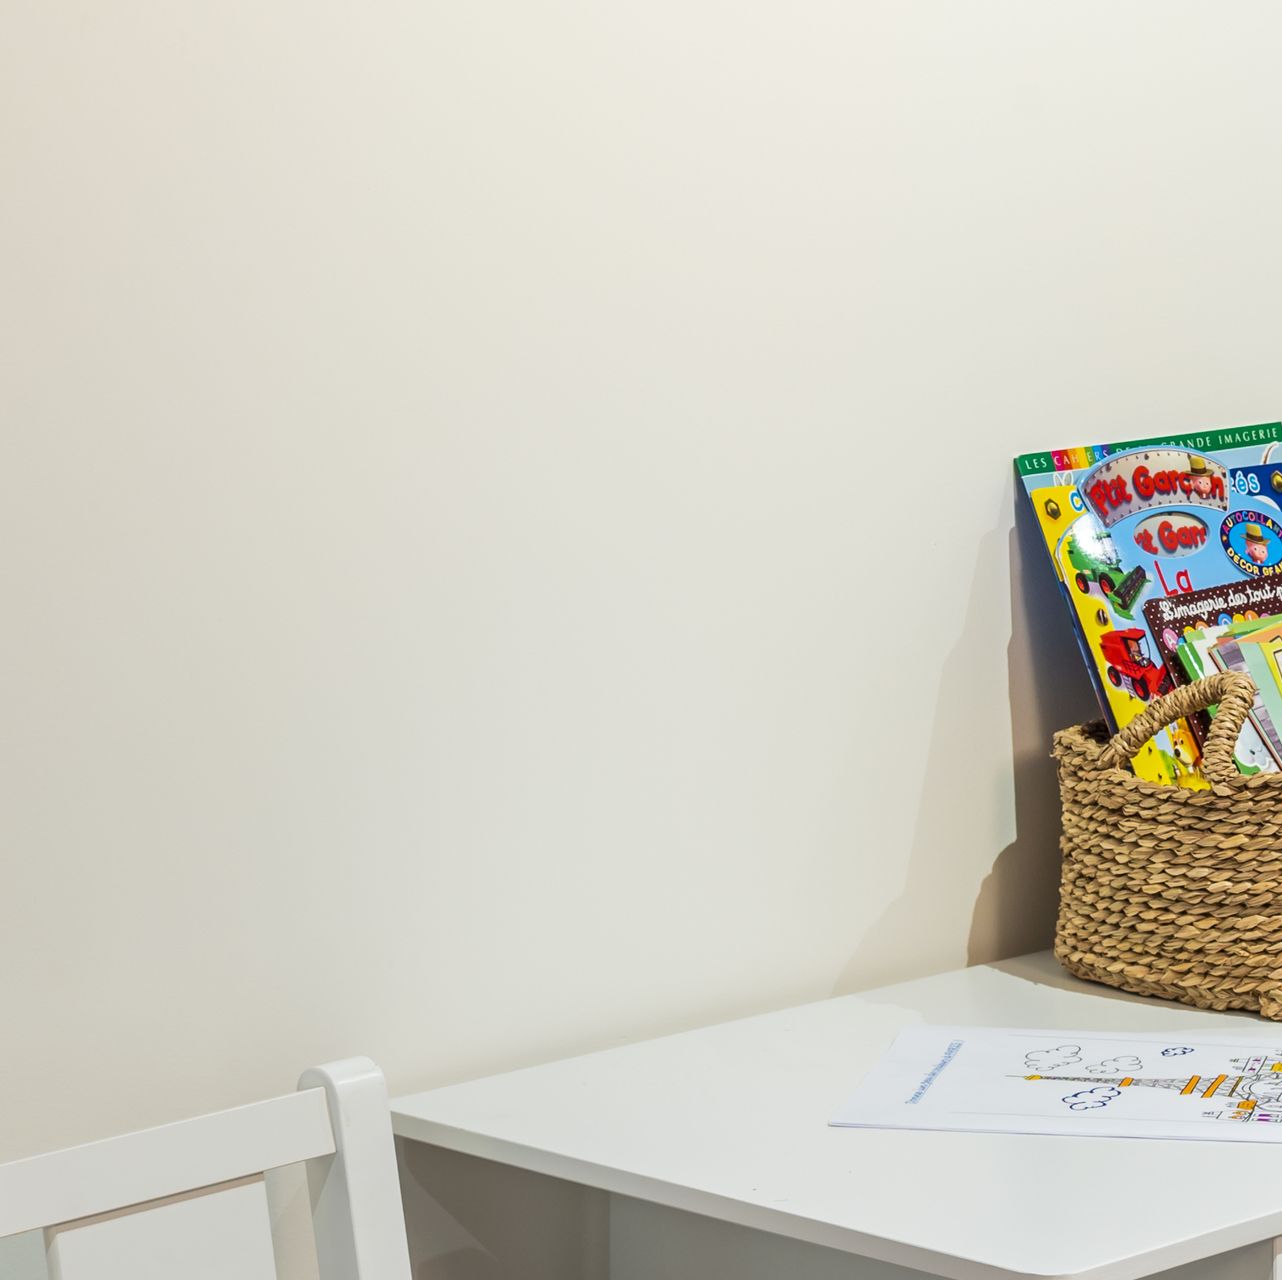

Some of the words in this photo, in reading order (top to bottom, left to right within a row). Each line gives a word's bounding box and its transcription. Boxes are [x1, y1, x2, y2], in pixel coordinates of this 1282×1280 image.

[1024, 456, 1048, 470] LES
[1053, 448, 1110, 467] CAHERS
[1218, 427, 1279, 445] IMAGERIE
[1154, 560, 1194, 597] La
[1158, 596, 1228, 622] L'imagerie
[1228, 589, 1249, 609] des
[1245, 582, 1275, 605] tout
